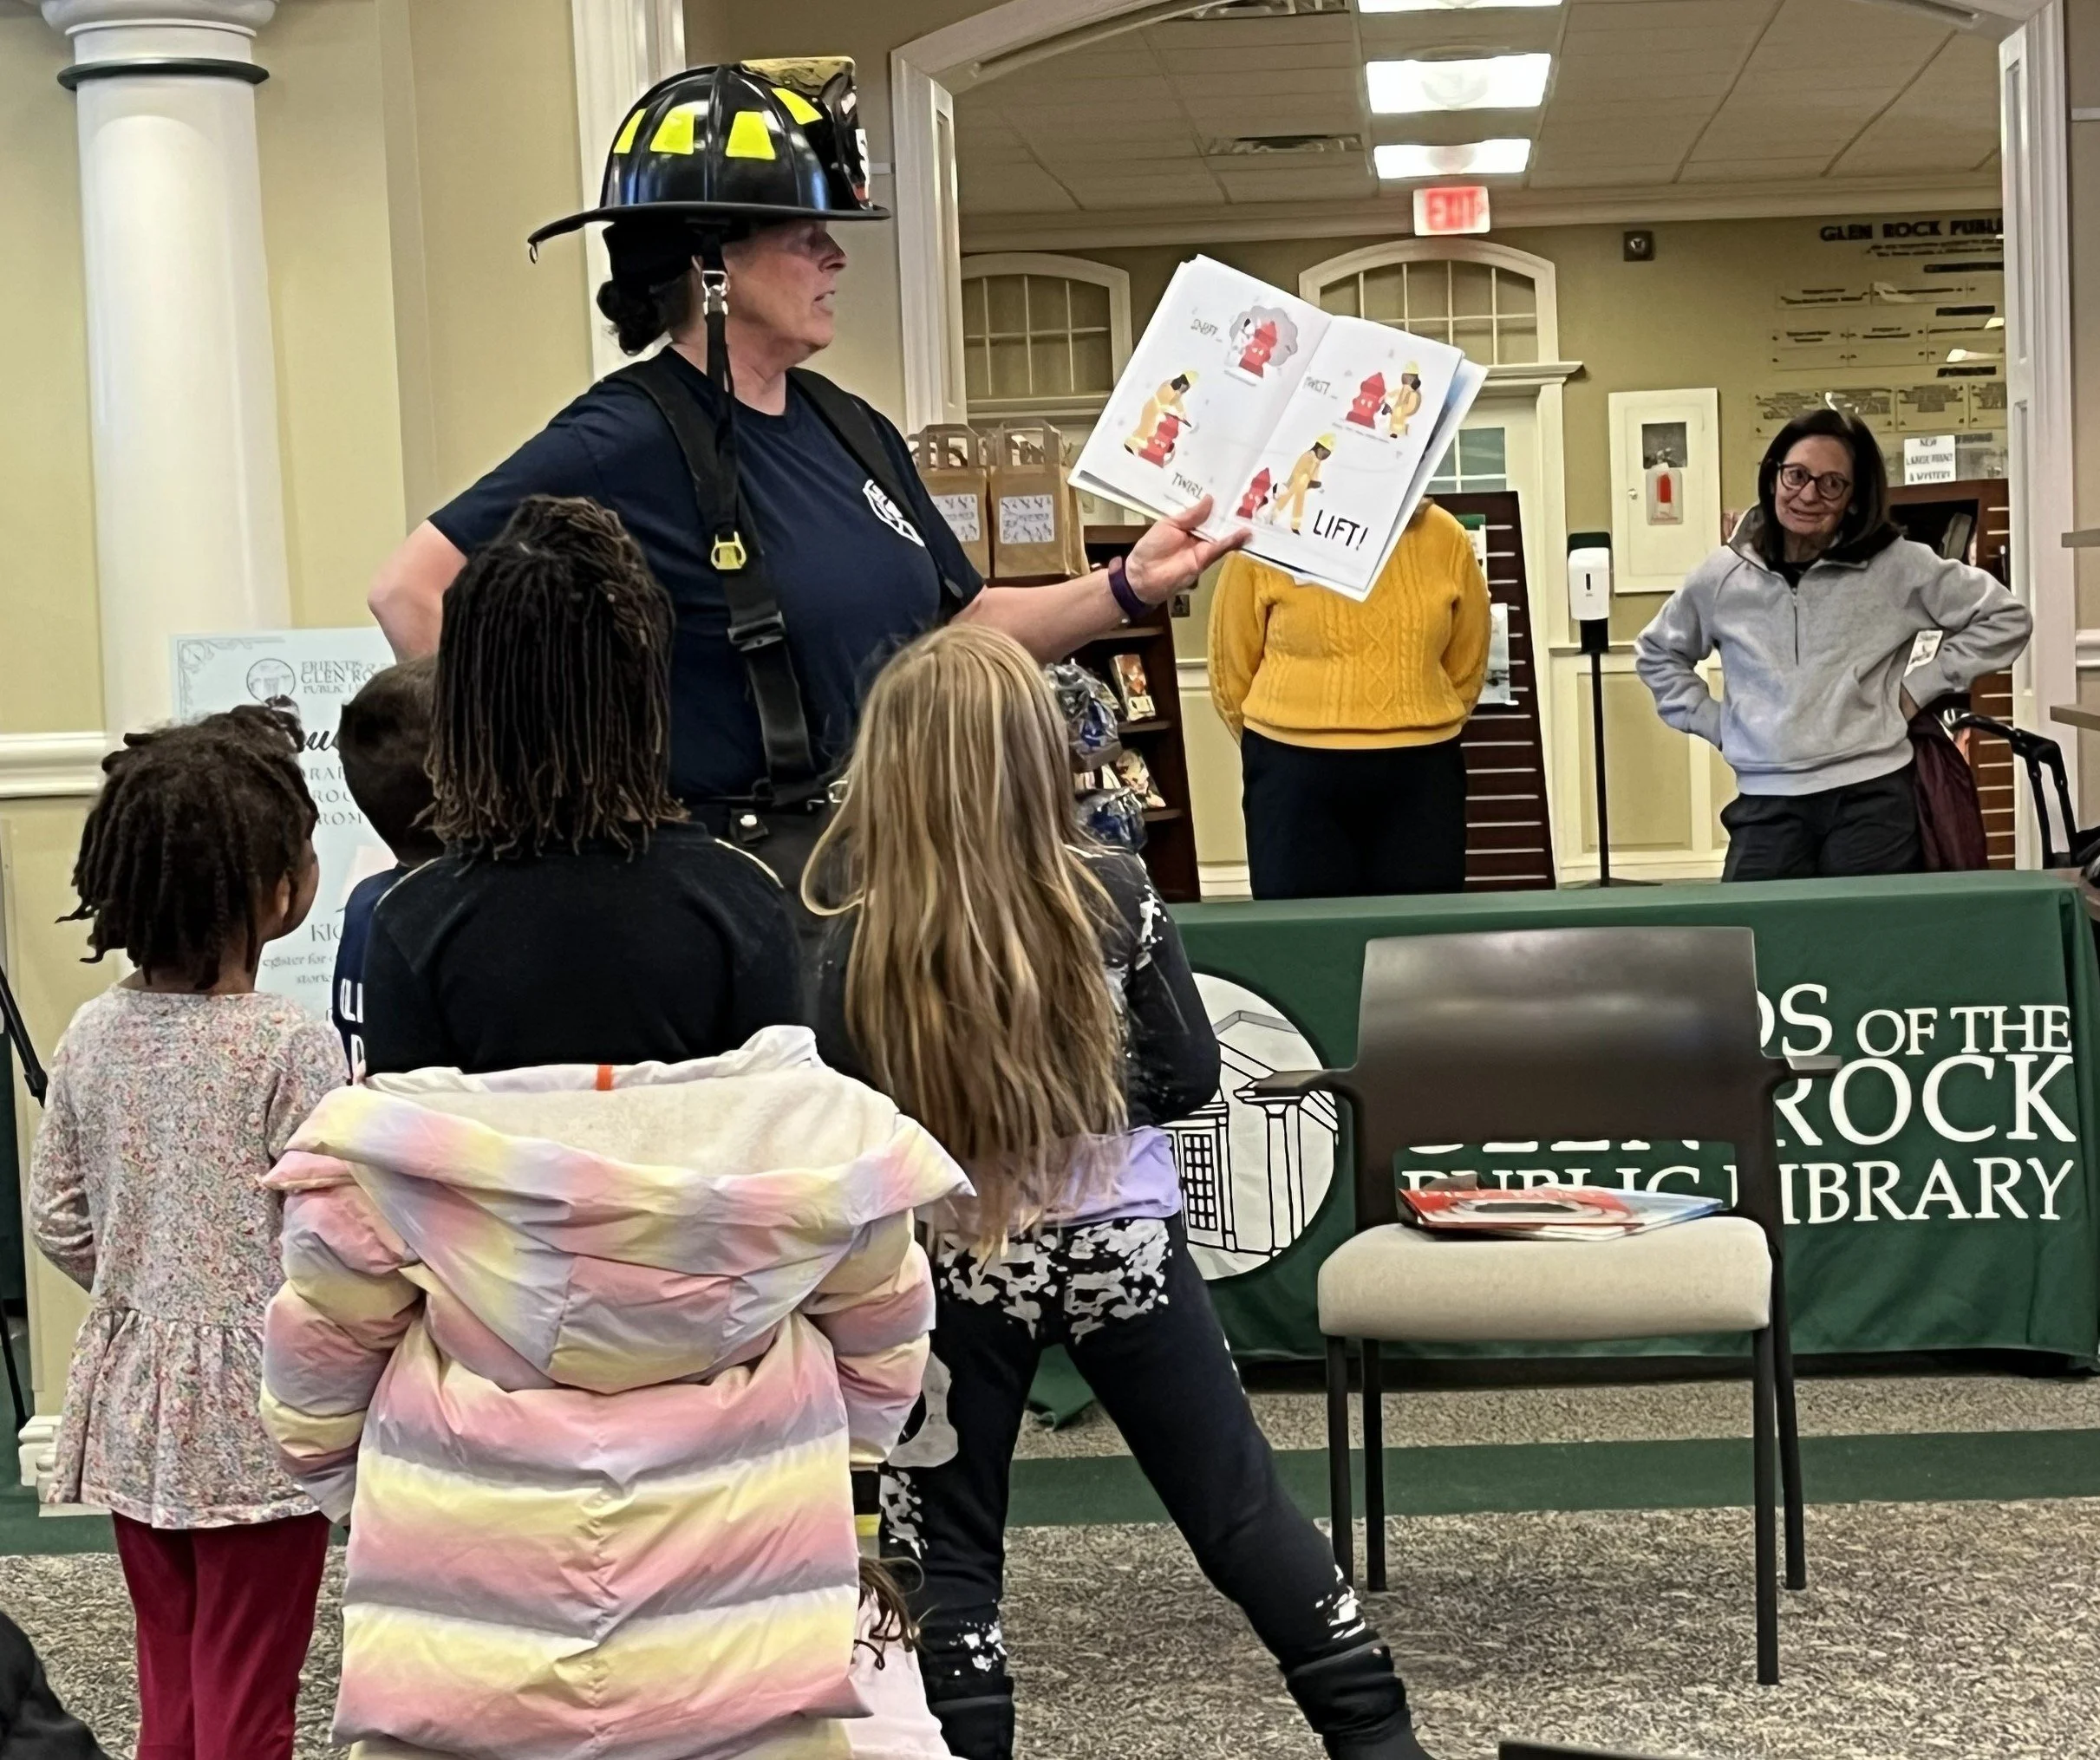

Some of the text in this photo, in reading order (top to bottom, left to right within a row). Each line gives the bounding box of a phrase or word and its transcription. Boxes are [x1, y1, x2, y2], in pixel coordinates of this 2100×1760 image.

[1427, 189, 1477, 231] EXIT
[1820, 224, 1873, 241] GLEN
[1882, 219, 1942, 238] ROCK
[1313, 509, 1368, 551] LIFT!
[1856, 1007, 1938, 1057] OF
[1950, 1005, 2073, 1054] THE
